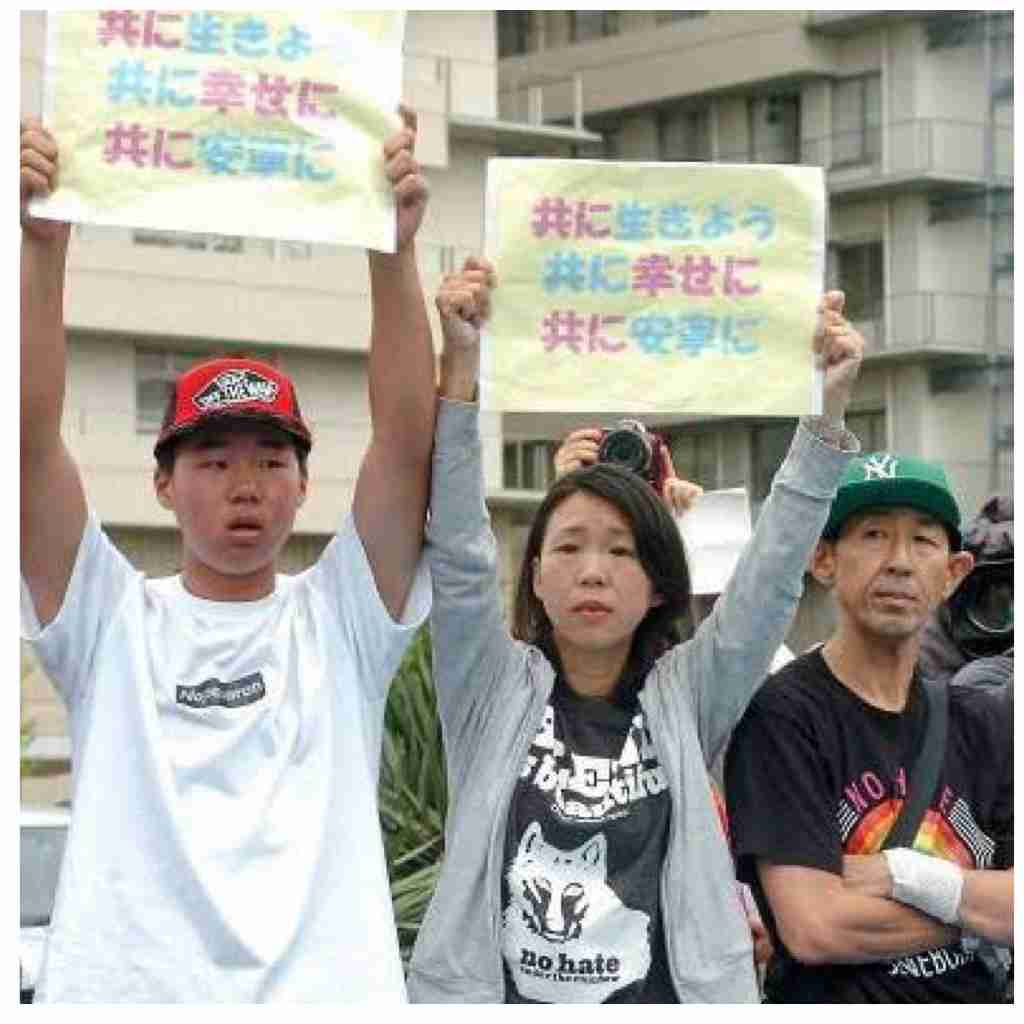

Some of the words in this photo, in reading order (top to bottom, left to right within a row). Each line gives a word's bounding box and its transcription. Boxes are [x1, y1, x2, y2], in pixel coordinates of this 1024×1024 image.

[531, 197, 776, 240] 共に生きよう
[541, 251, 760, 297] 共に幸せに
[520, 948, 553, 971] no
[558, 953, 621, 975] hate
